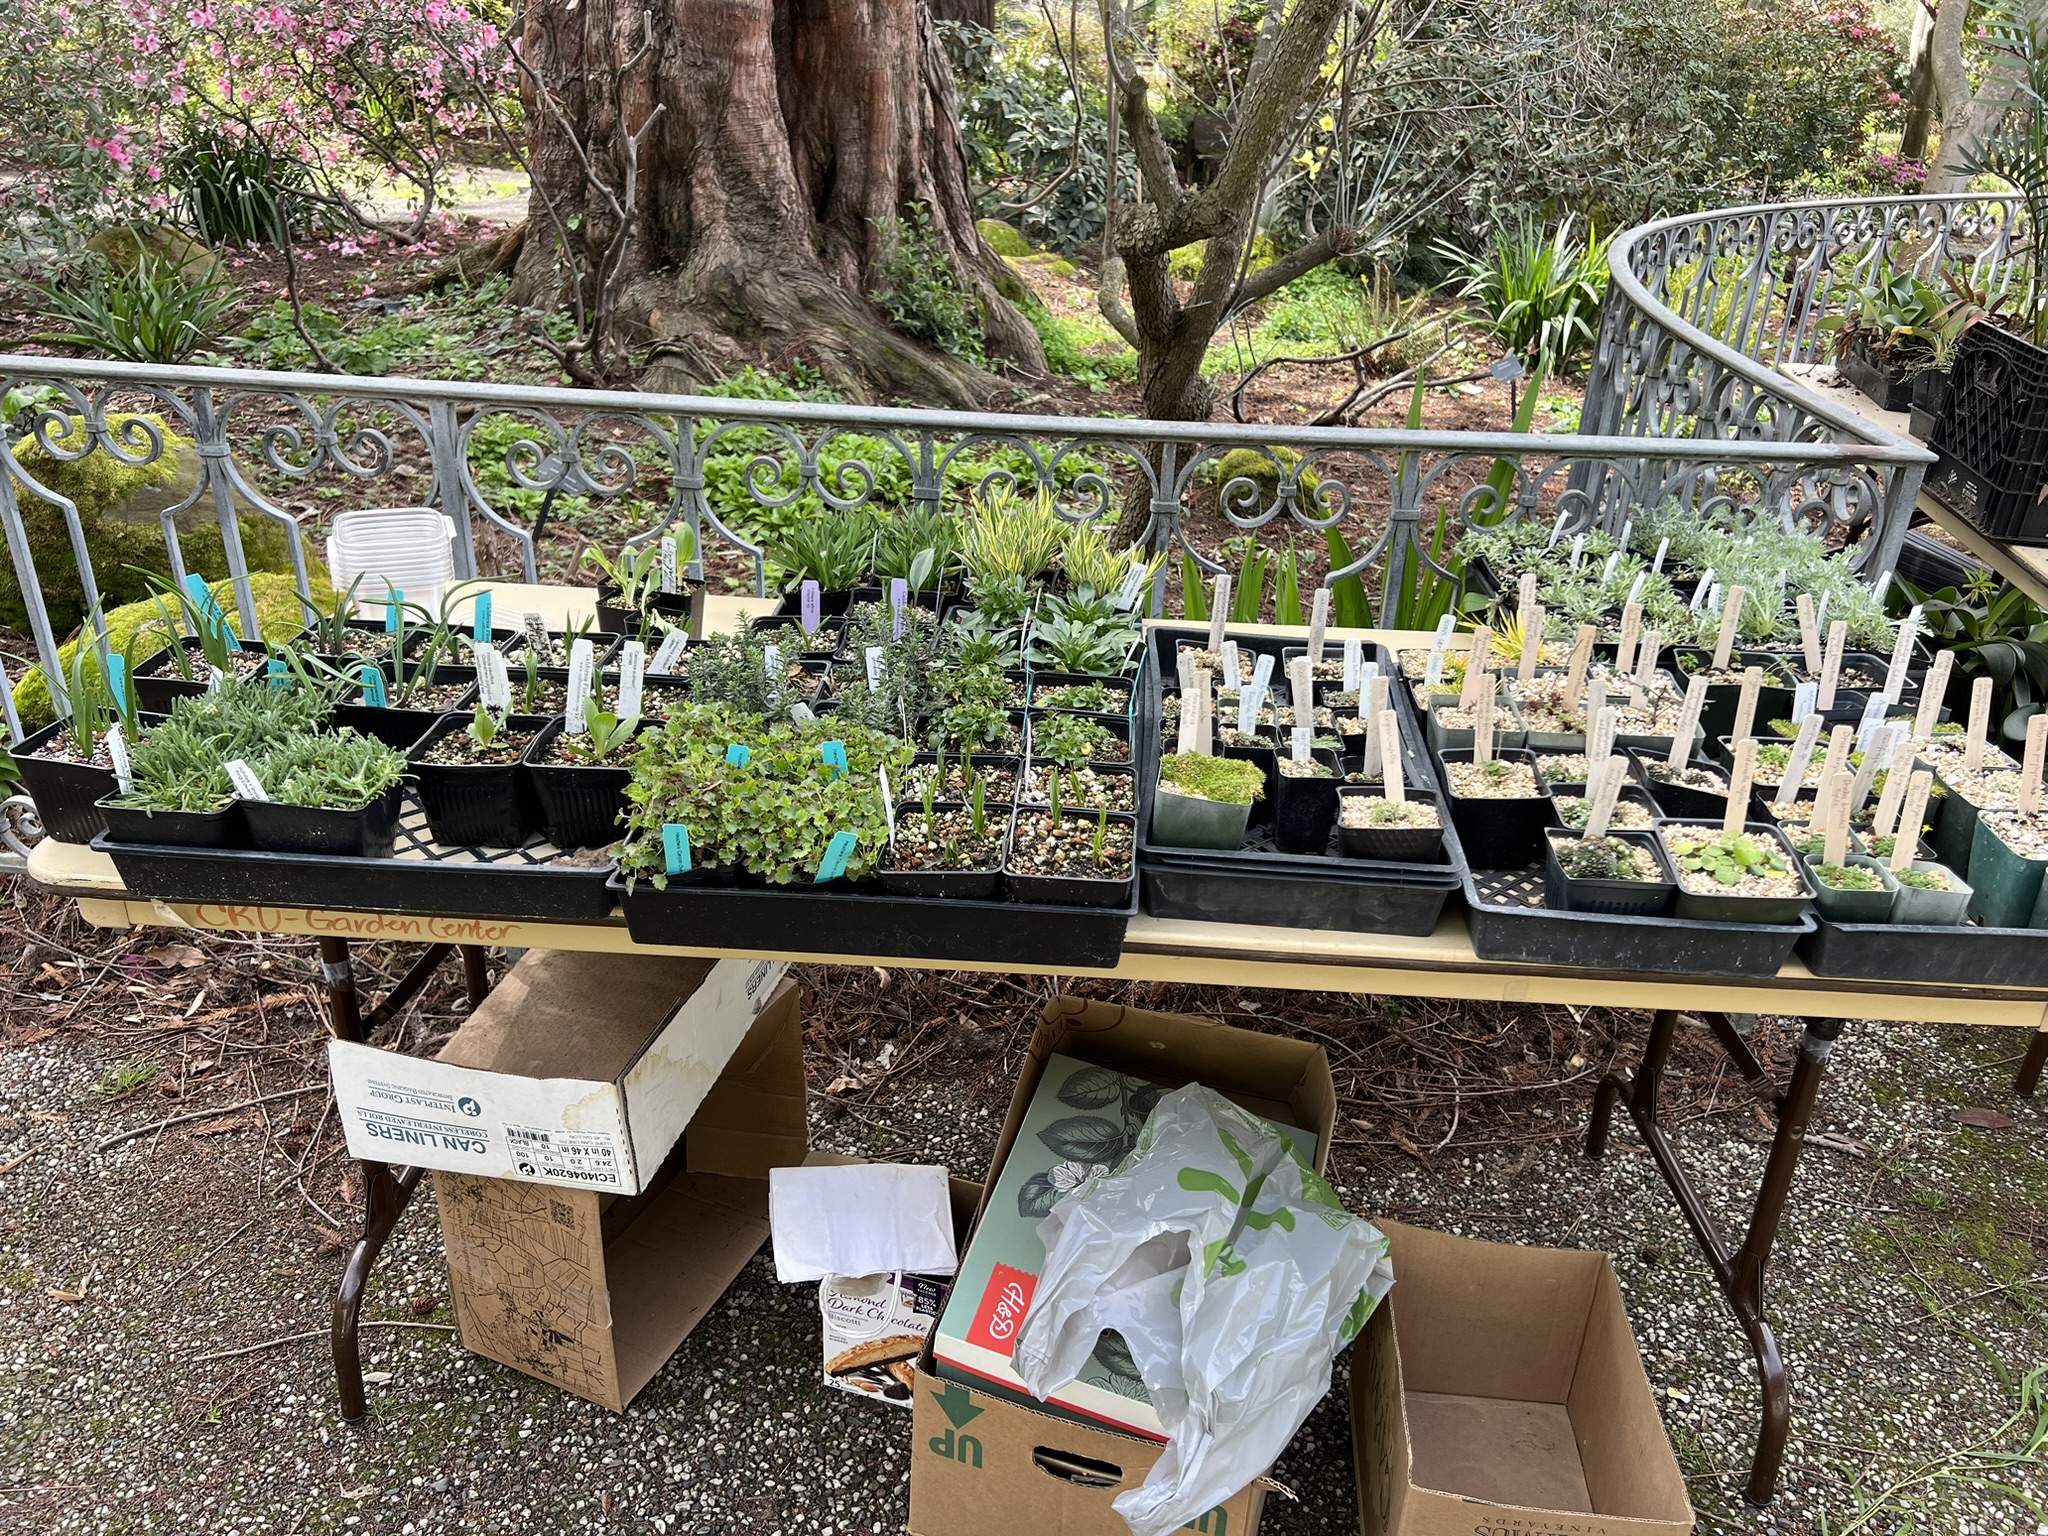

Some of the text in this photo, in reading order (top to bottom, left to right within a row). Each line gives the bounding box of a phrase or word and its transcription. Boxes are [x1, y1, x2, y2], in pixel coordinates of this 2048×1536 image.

[427, 917, 523, 939] Center
[369, 1089, 456, 1113] INTEPLAST GROUP
[357, 1110, 385, 1121] ROLLS
[385, 1116, 442, 1131] INTERLEAVED
[365, 1122, 487, 1155] CAN LINERS
[443, 1126, 488, 1139] CORELESS
[510, 1138, 530, 1147] BLACK
[516, 1150, 529, 1158] 100
[561, 1145, 570, 1154] in
[570, 1146, 582, 1155] 46
[590, 1147, 600, 1156] in
[601, 1148, 612, 1157] 40
[594, 1159, 612, 1167] 24.6
[543, 1166, 617, 1183] ECI404620K
[917, 1295, 937, 1308] 85%
[828, 1297, 865, 1316] Dark
[866, 1307, 928, 1333] Chcolate
[829, 1378, 841, 1388] 25
[928, 1428, 983, 1469] UP
[1482, 1515, 1607, 1535] VINEYARDS
